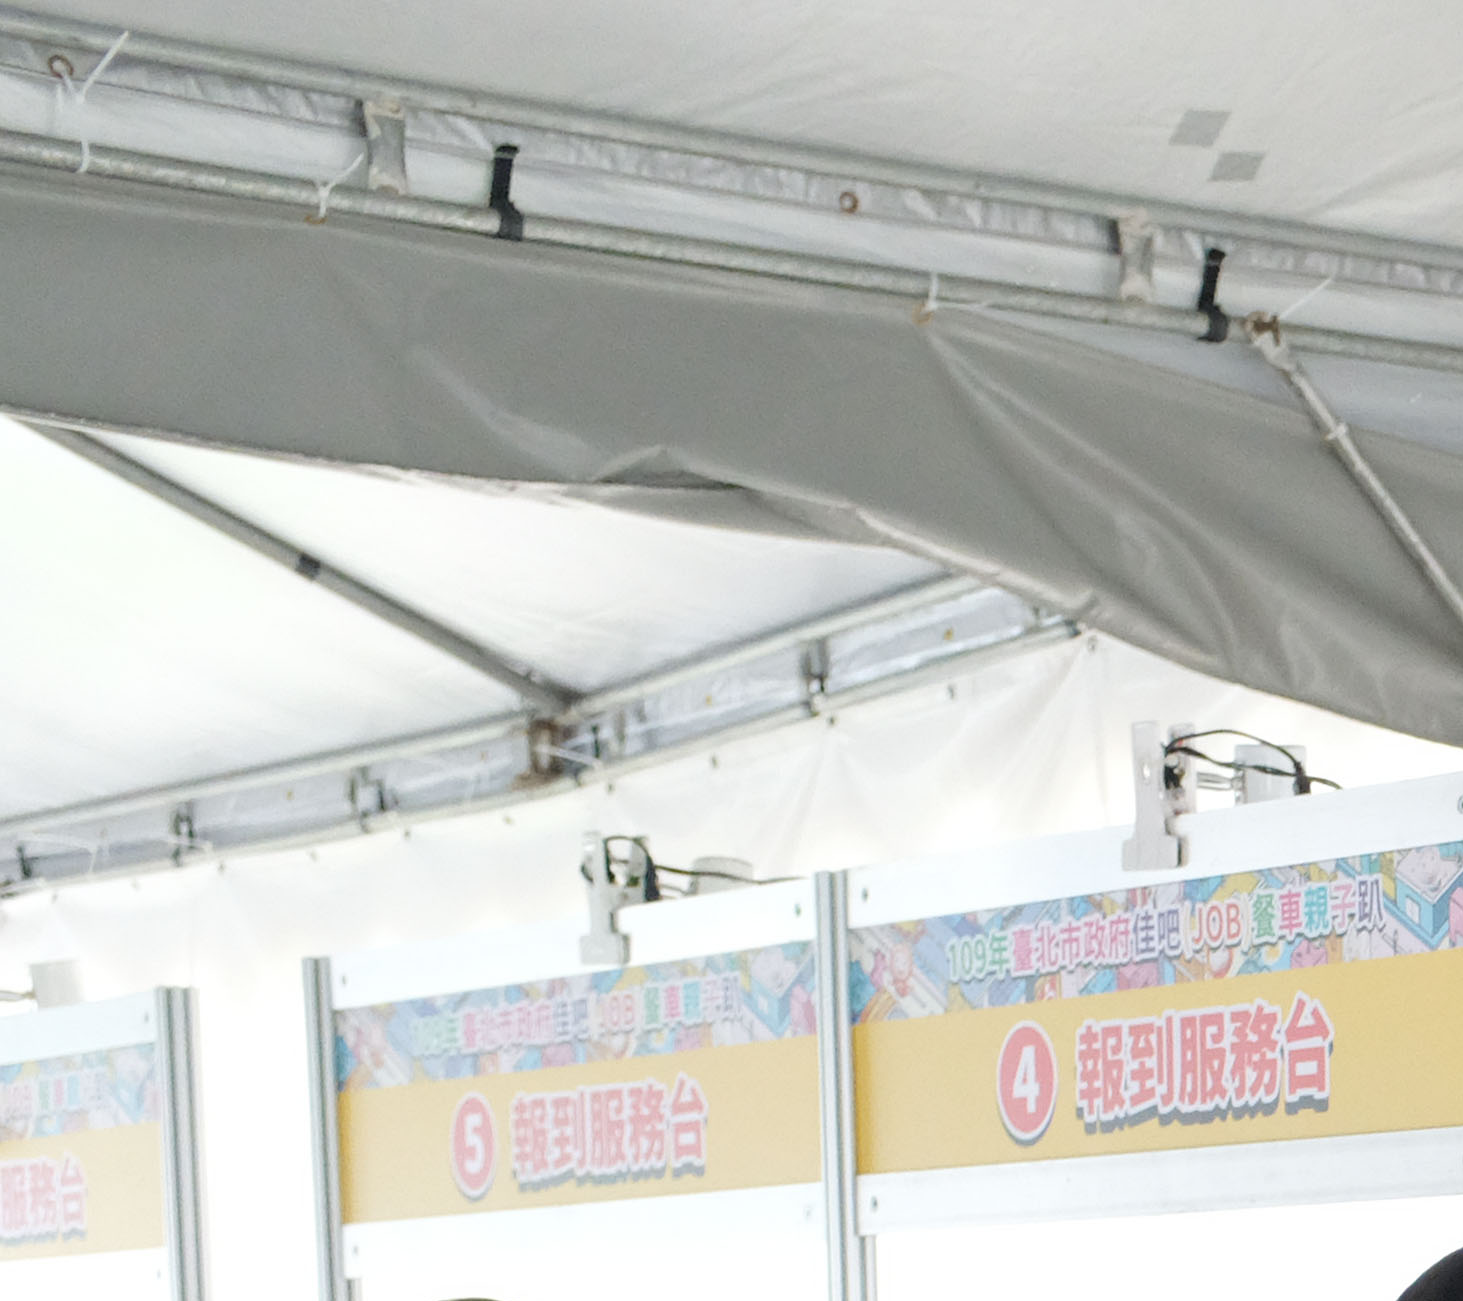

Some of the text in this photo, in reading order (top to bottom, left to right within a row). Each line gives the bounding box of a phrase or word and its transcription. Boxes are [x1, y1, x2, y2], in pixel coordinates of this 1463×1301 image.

[1076, 998, 1331, 1118] 報到服務台
[513, 1076, 706, 1176] 報到服務台
